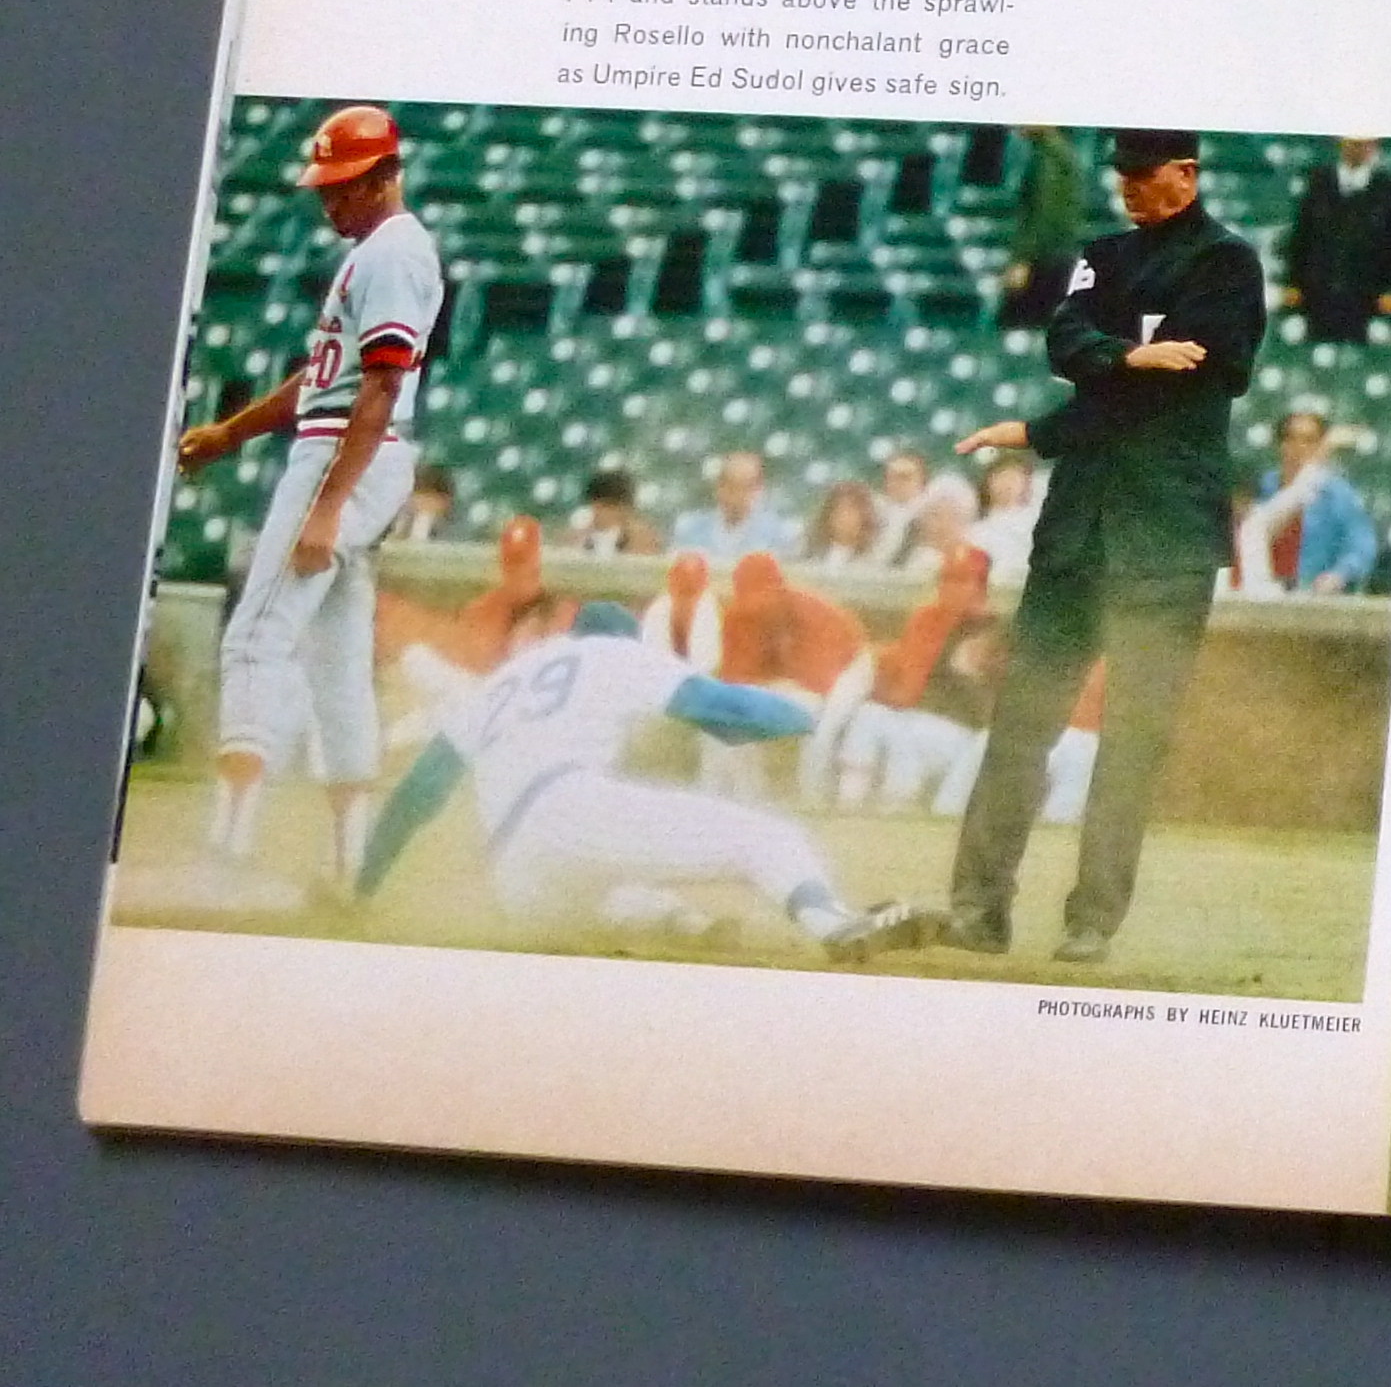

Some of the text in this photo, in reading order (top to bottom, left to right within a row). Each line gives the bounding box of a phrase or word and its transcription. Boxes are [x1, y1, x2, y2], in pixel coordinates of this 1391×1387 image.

[562, 22, 1010, 60] ing Rosello with nonchalant grace
[557, 62, 1006, 102] as Umpire Ed Sudol gives safe sign.
[1037, 999, 1362, 1033] PHOTOGRAPHS BY HEINZ KLUETMEIER
